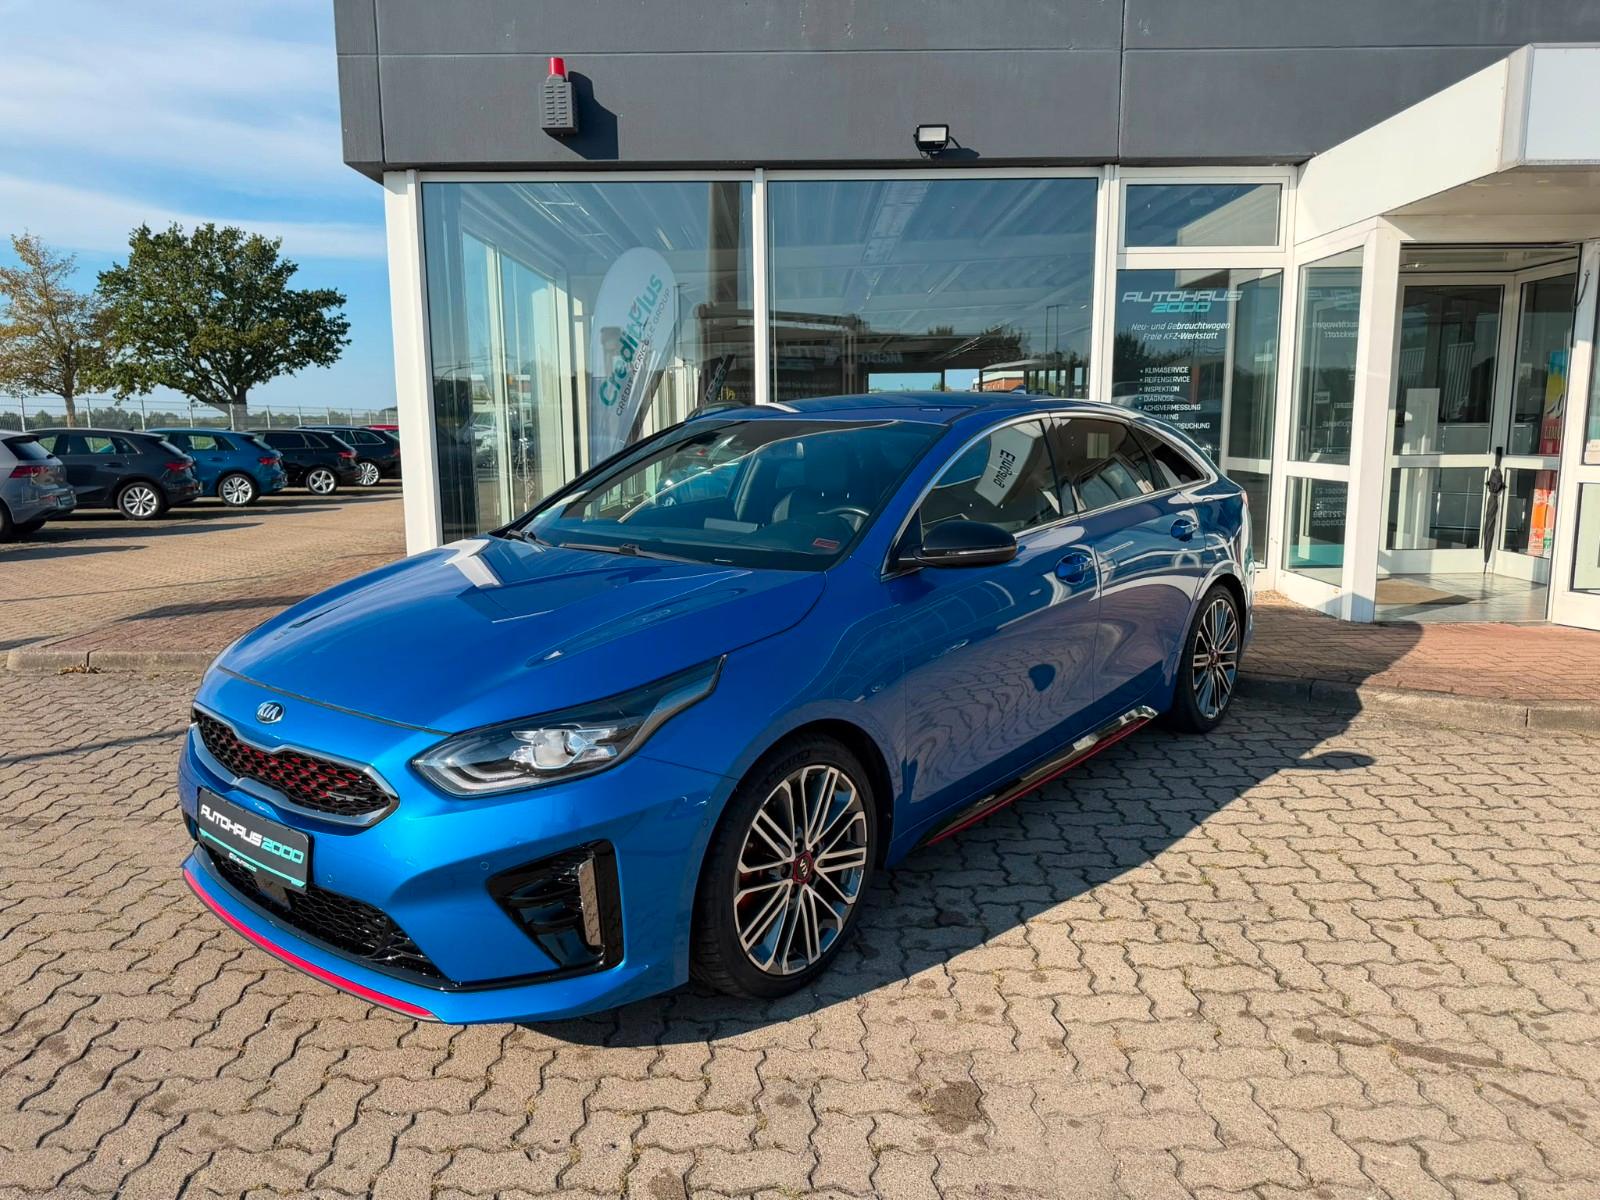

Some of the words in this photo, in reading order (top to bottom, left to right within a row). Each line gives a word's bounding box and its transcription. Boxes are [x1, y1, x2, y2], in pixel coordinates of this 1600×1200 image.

[1121, 290, 1245, 303] AUTOHAUS
[1151, 302, 1212, 313] 2000
[1151, 322, 1167, 330] und
[1167, 321, 1231, 331] Gebrauchtwagen
[1163, 332, 1219, 340] KFZ-Werkstatt
[1144, 366, 1189, 374] KLIMASERVICE
[1144, 385, 1180, 393] INSPEKTION
[1143, 403, 1201, 411] ACHSVERMESSUNG
[257, 702, 281, 720] KIA
